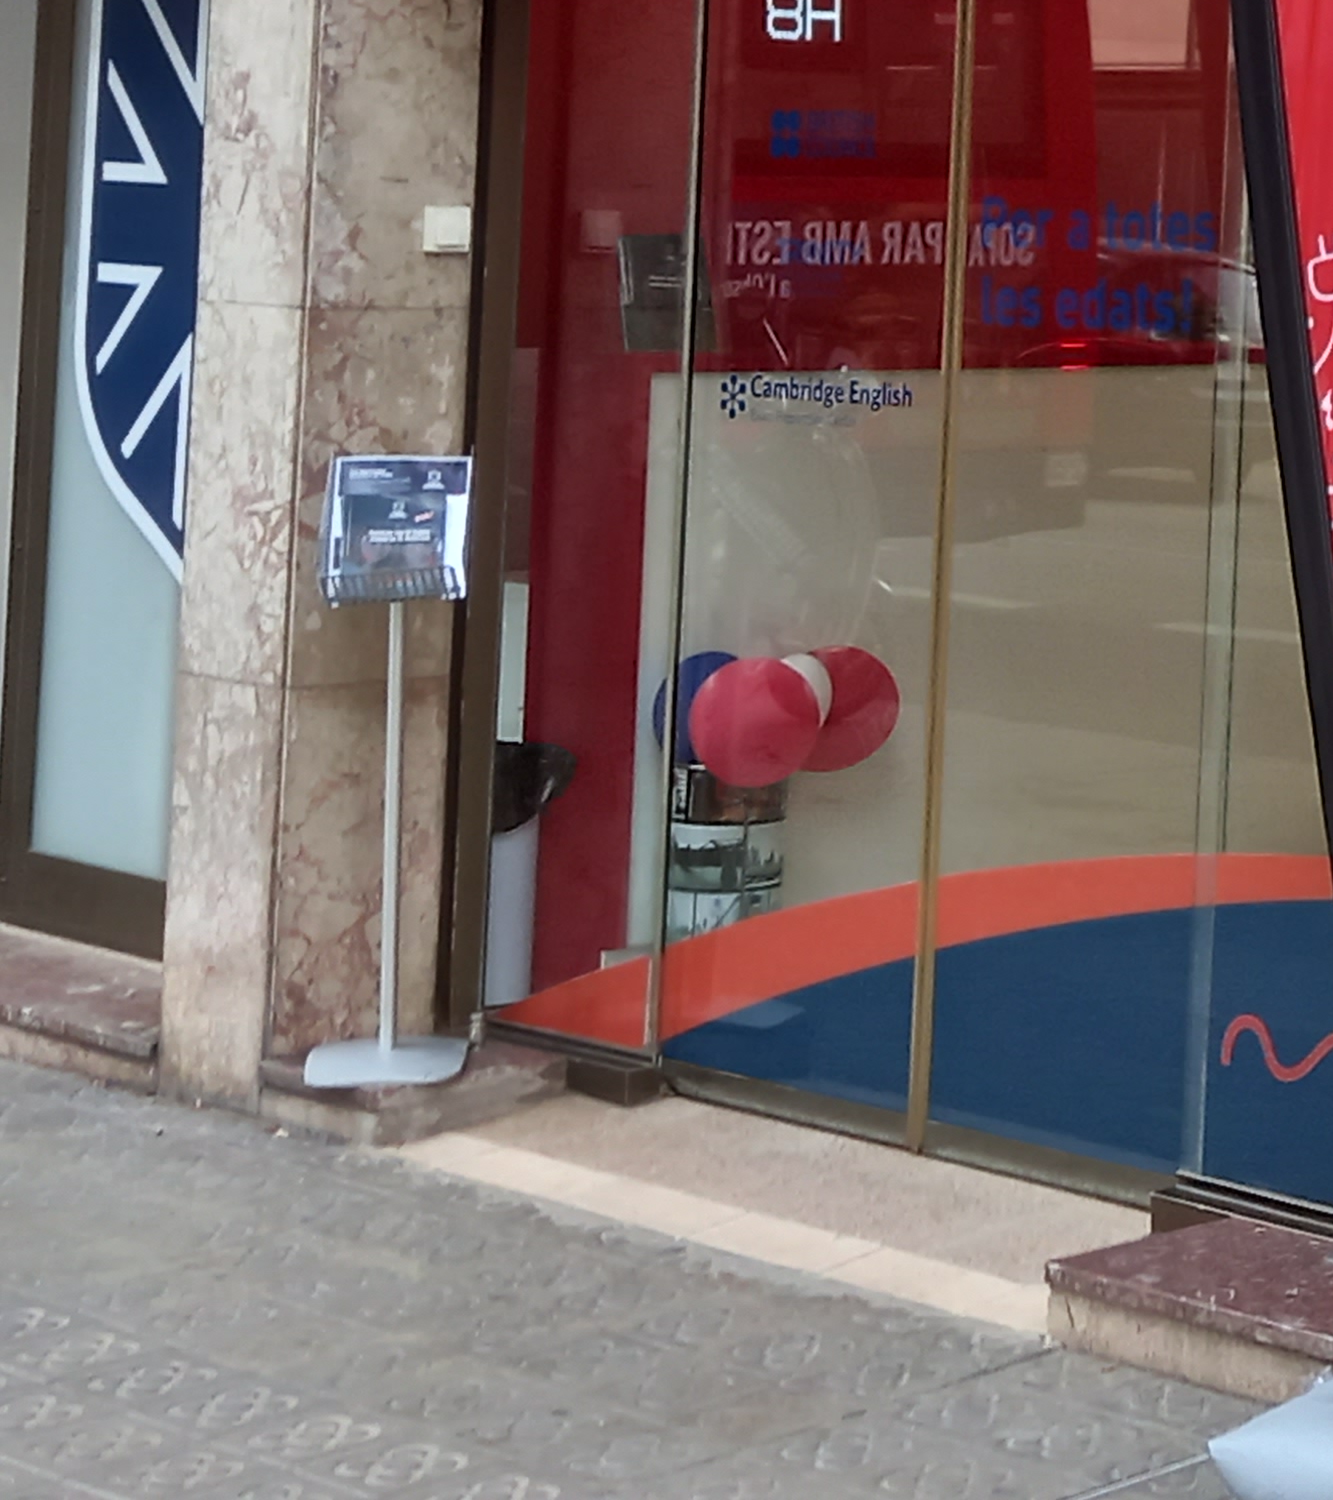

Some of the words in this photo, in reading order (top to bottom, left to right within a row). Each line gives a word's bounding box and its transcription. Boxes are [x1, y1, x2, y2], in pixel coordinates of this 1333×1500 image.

[981, 196, 1054, 249] Per
[1067, 208, 1094, 250] a
[1105, 202, 1217, 253] totes
[981, 277, 1042, 329] les
[1055, 279, 1193, 334] edats!
[749, 374, 845, 406] Cambridge
[848, 380, 913, 411] English
